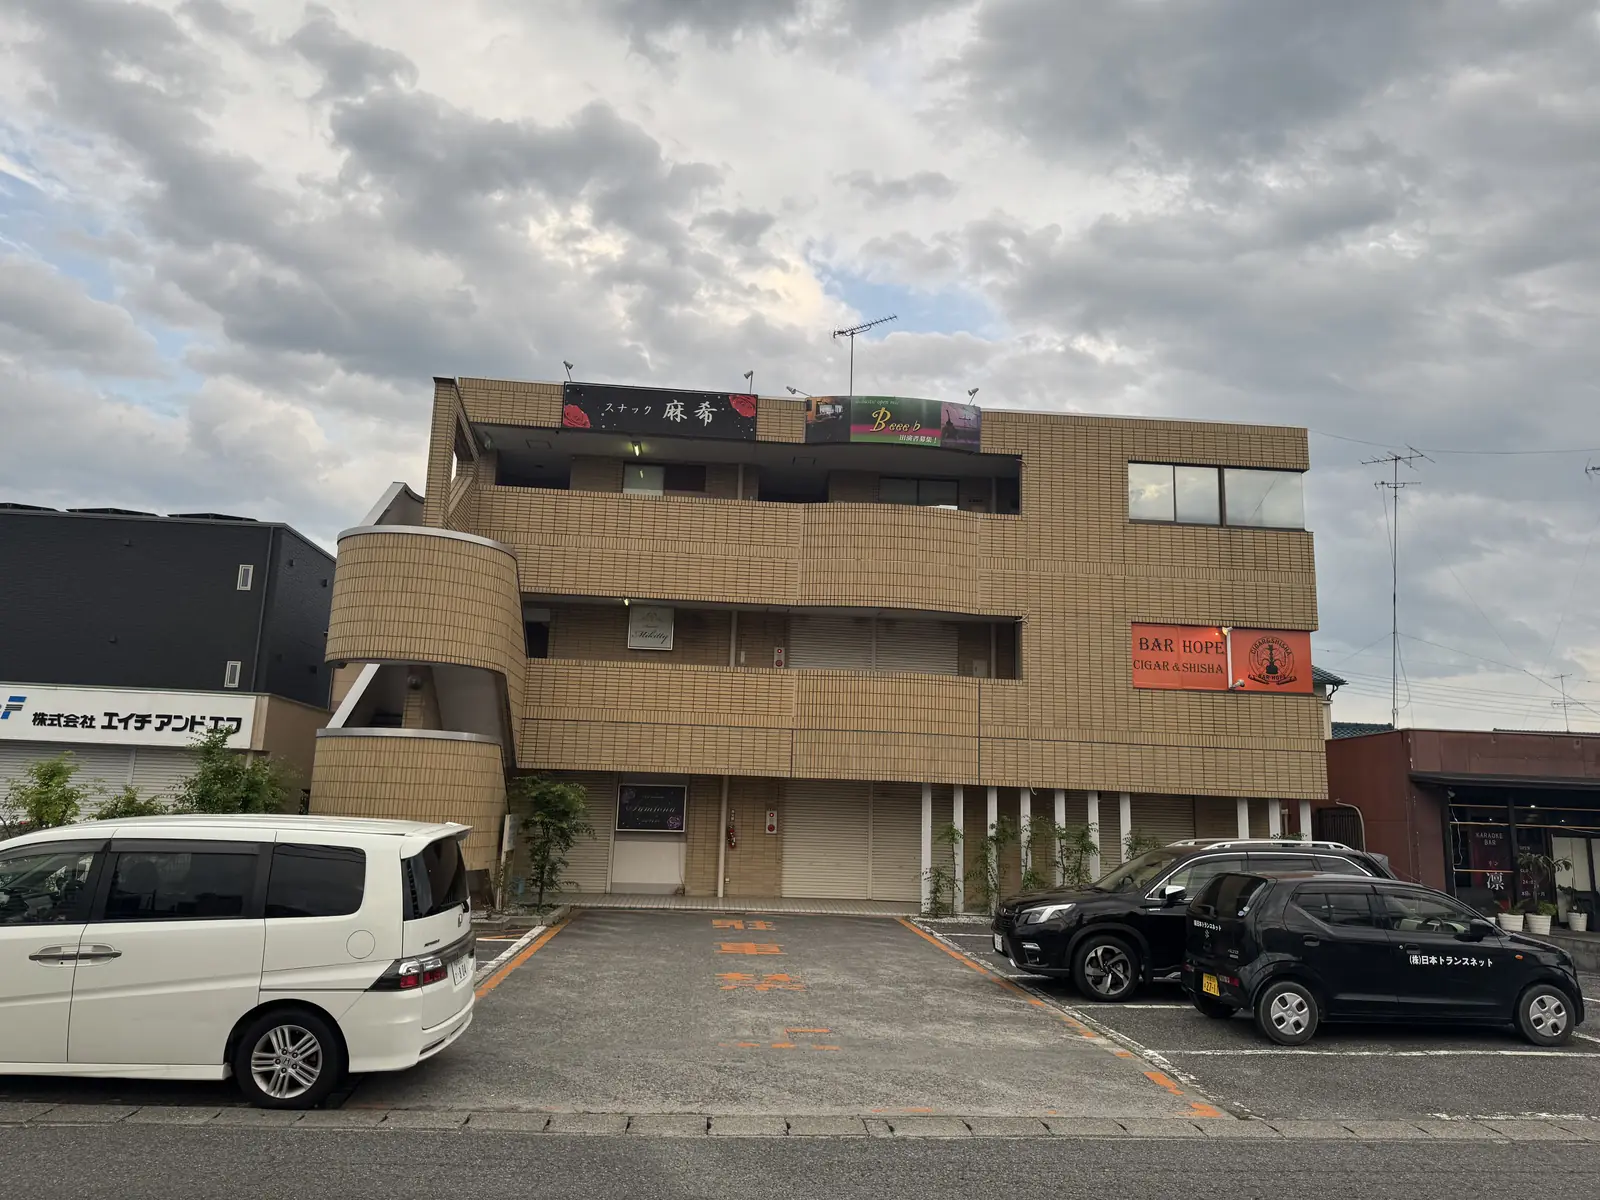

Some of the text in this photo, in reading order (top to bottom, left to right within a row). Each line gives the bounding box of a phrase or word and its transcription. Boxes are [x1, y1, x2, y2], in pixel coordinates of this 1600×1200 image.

[605, 399, 718, 427] スナック 麻希
[1139, 637, 1225, 655] BAR HOPE
[1133, 660, 1224, 674] CIGAR & SHISHA
[32, 711, 243, 735] 株式会社 エイチアンドエフ
[1475, 832, 1503, 840] KARAOKE
[1409, 954, 1493, 968] (株)日本トランスネット
